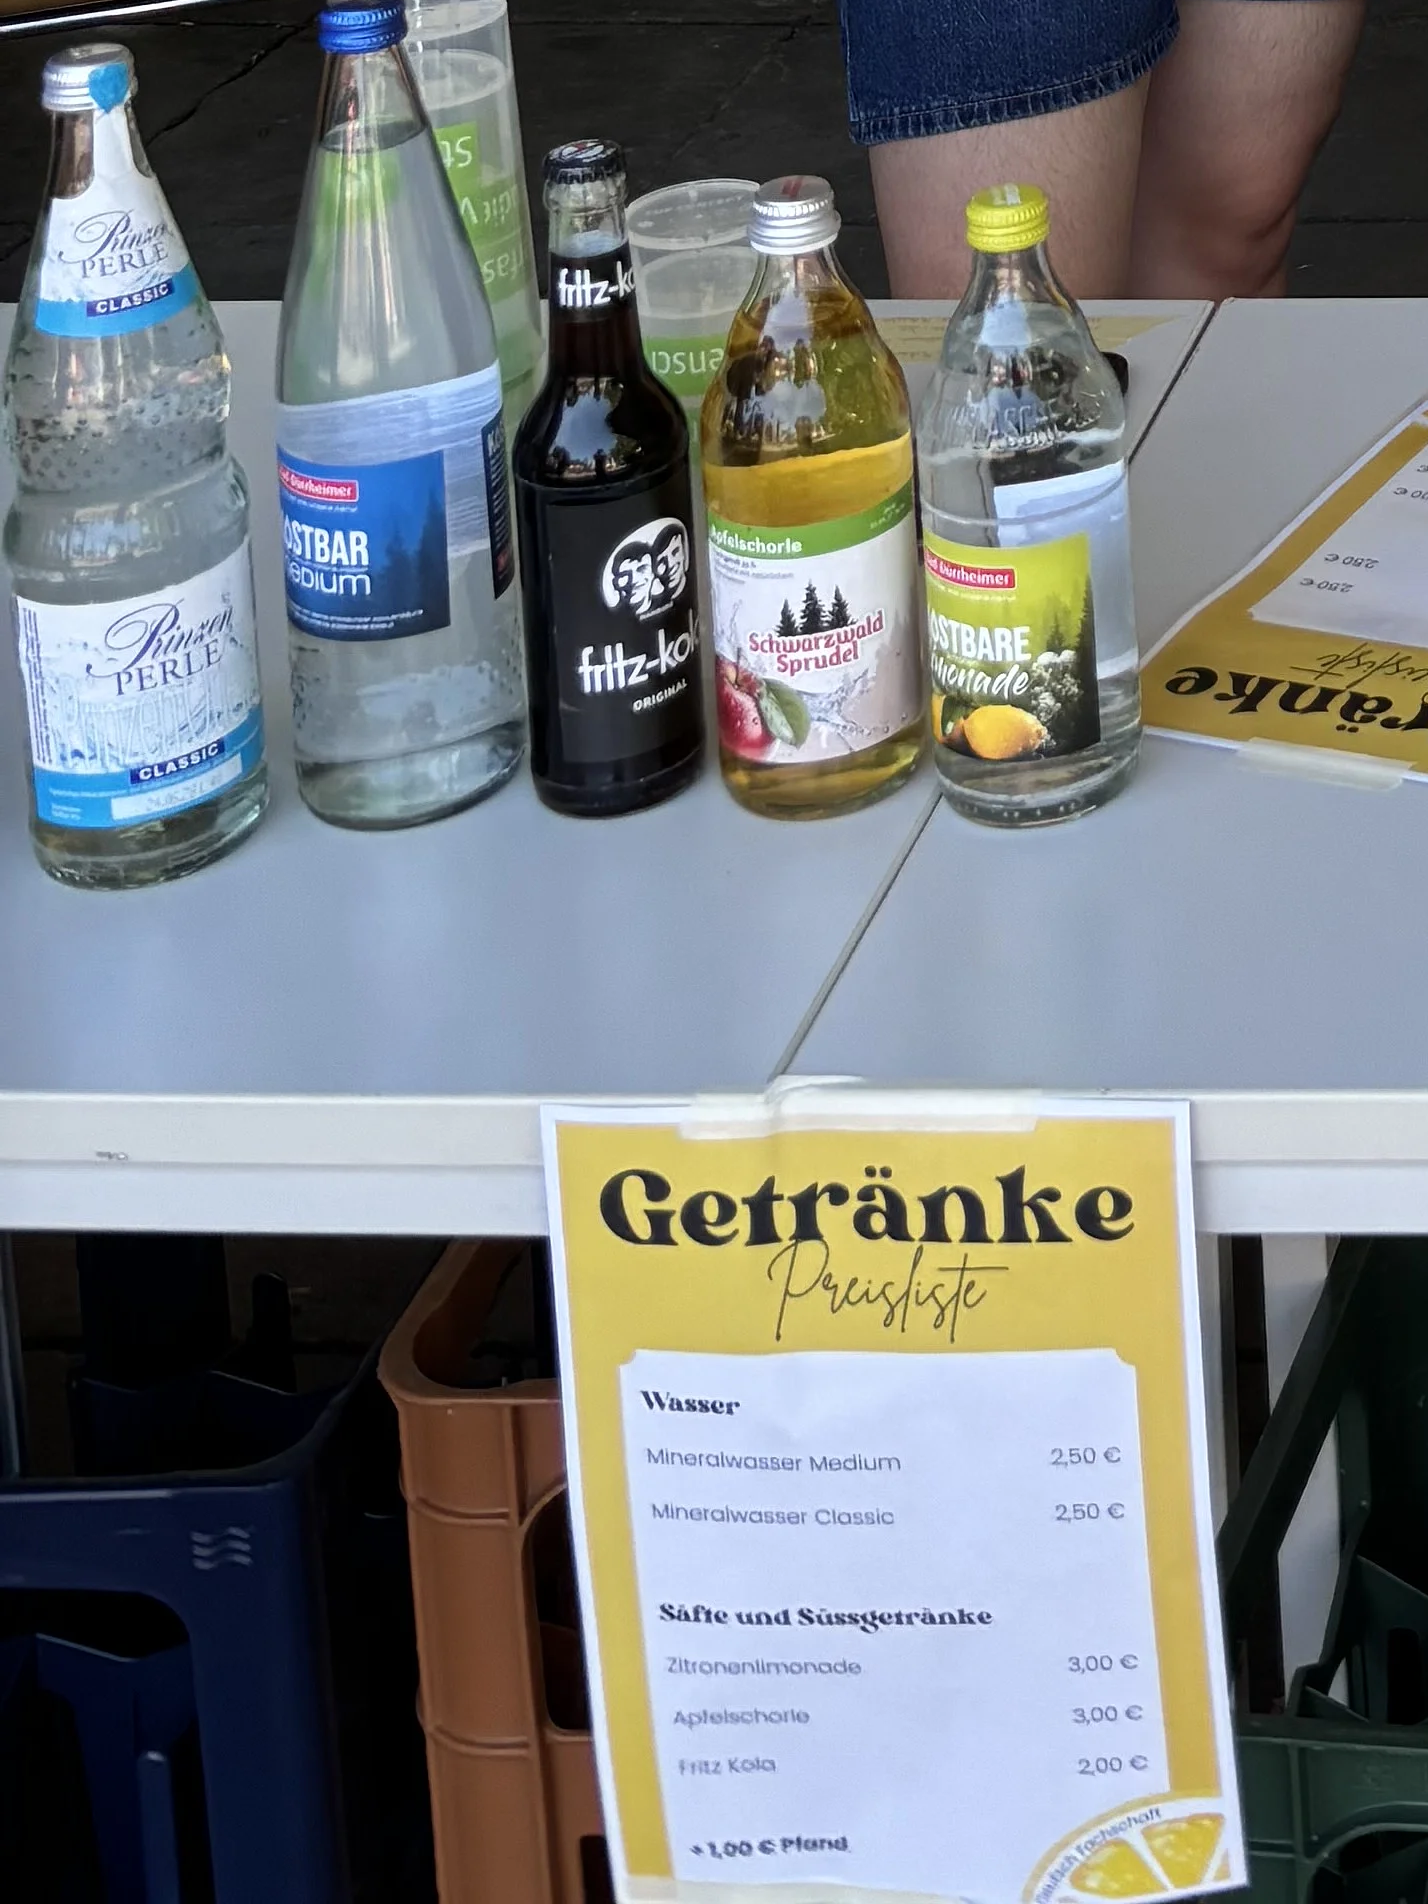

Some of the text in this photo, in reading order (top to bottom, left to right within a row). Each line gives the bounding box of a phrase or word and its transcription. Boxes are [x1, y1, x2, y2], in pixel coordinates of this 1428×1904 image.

[81, 242, 169, 279] PERLE
[95, 283, 170, 314] CLASSIC
[284, 515, 370, 566] OSTBAR
[86, 597, 234, 678] Prinzen
[748, 610, 885, 654] Schwarzwald
[928, 609, 1032, 662] OSTBARE
[115, 639, 222, 696] PERLE
[776, 644, 859, 677] Sprudel
[632, 678, 688, 713] ORIGINAL
[138, 742, 220, 782] CLASSIC
[600, 1164, 1135, 1247] Getränke
[767, 1239, 1009, 1344] Preisliste
[640, 1390, 741, 1416] Wasser
[646, 1446, 1122, 1472] Mineralwasser Medium 2,50 €
[651, 1502, 1125, 1526] Mineralwasser Classic 2,50 €
[659, 1602, 994, 1634] Säfte und Süssgetränke
[666, 1654, 1139, 1676] Zitronenlimonade 3,00 €
[673, 1704, 1144, 1730] Apfelschorle 3,00 €
[678, 1754, 1149, 1776] Fritz Kola 2,00 €
[758, 1839, 777, 1855] €
[780, 1835, 849, 1854] Pfand
